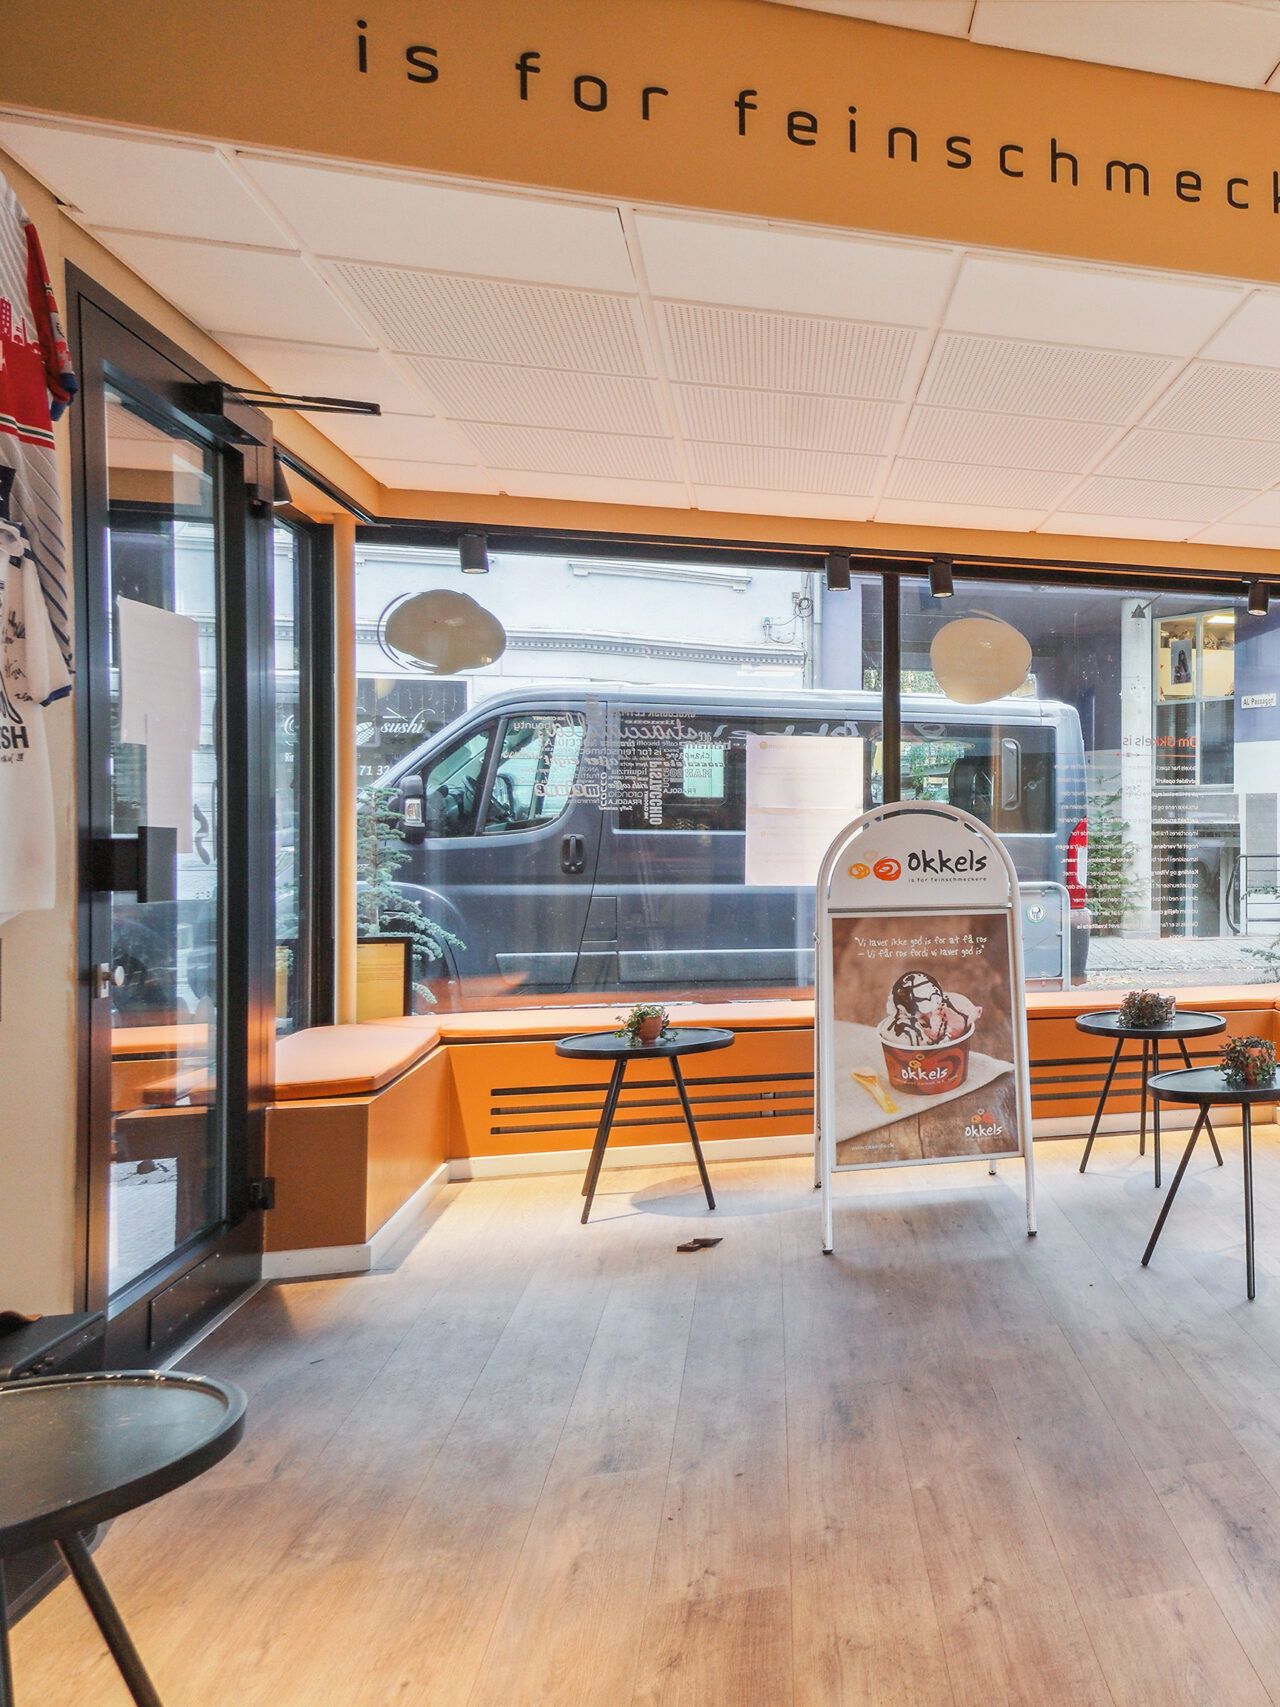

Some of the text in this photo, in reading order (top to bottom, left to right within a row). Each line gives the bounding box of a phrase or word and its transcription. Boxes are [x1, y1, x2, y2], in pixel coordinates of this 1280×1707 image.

[356, 18, 440, 84] is
[514, 51, 670, 121] for
[381, 713, 429, 734] sushi
[359, 765, 373, 776] 71
[910, 936, 925, 947] god
[934, 936, 946, 945] for
[948, 936, 960, 945] at
[975, 936, 988, 944] ros
[895, 949, 908, 958] ros
[960, 946, 974, 958] god
